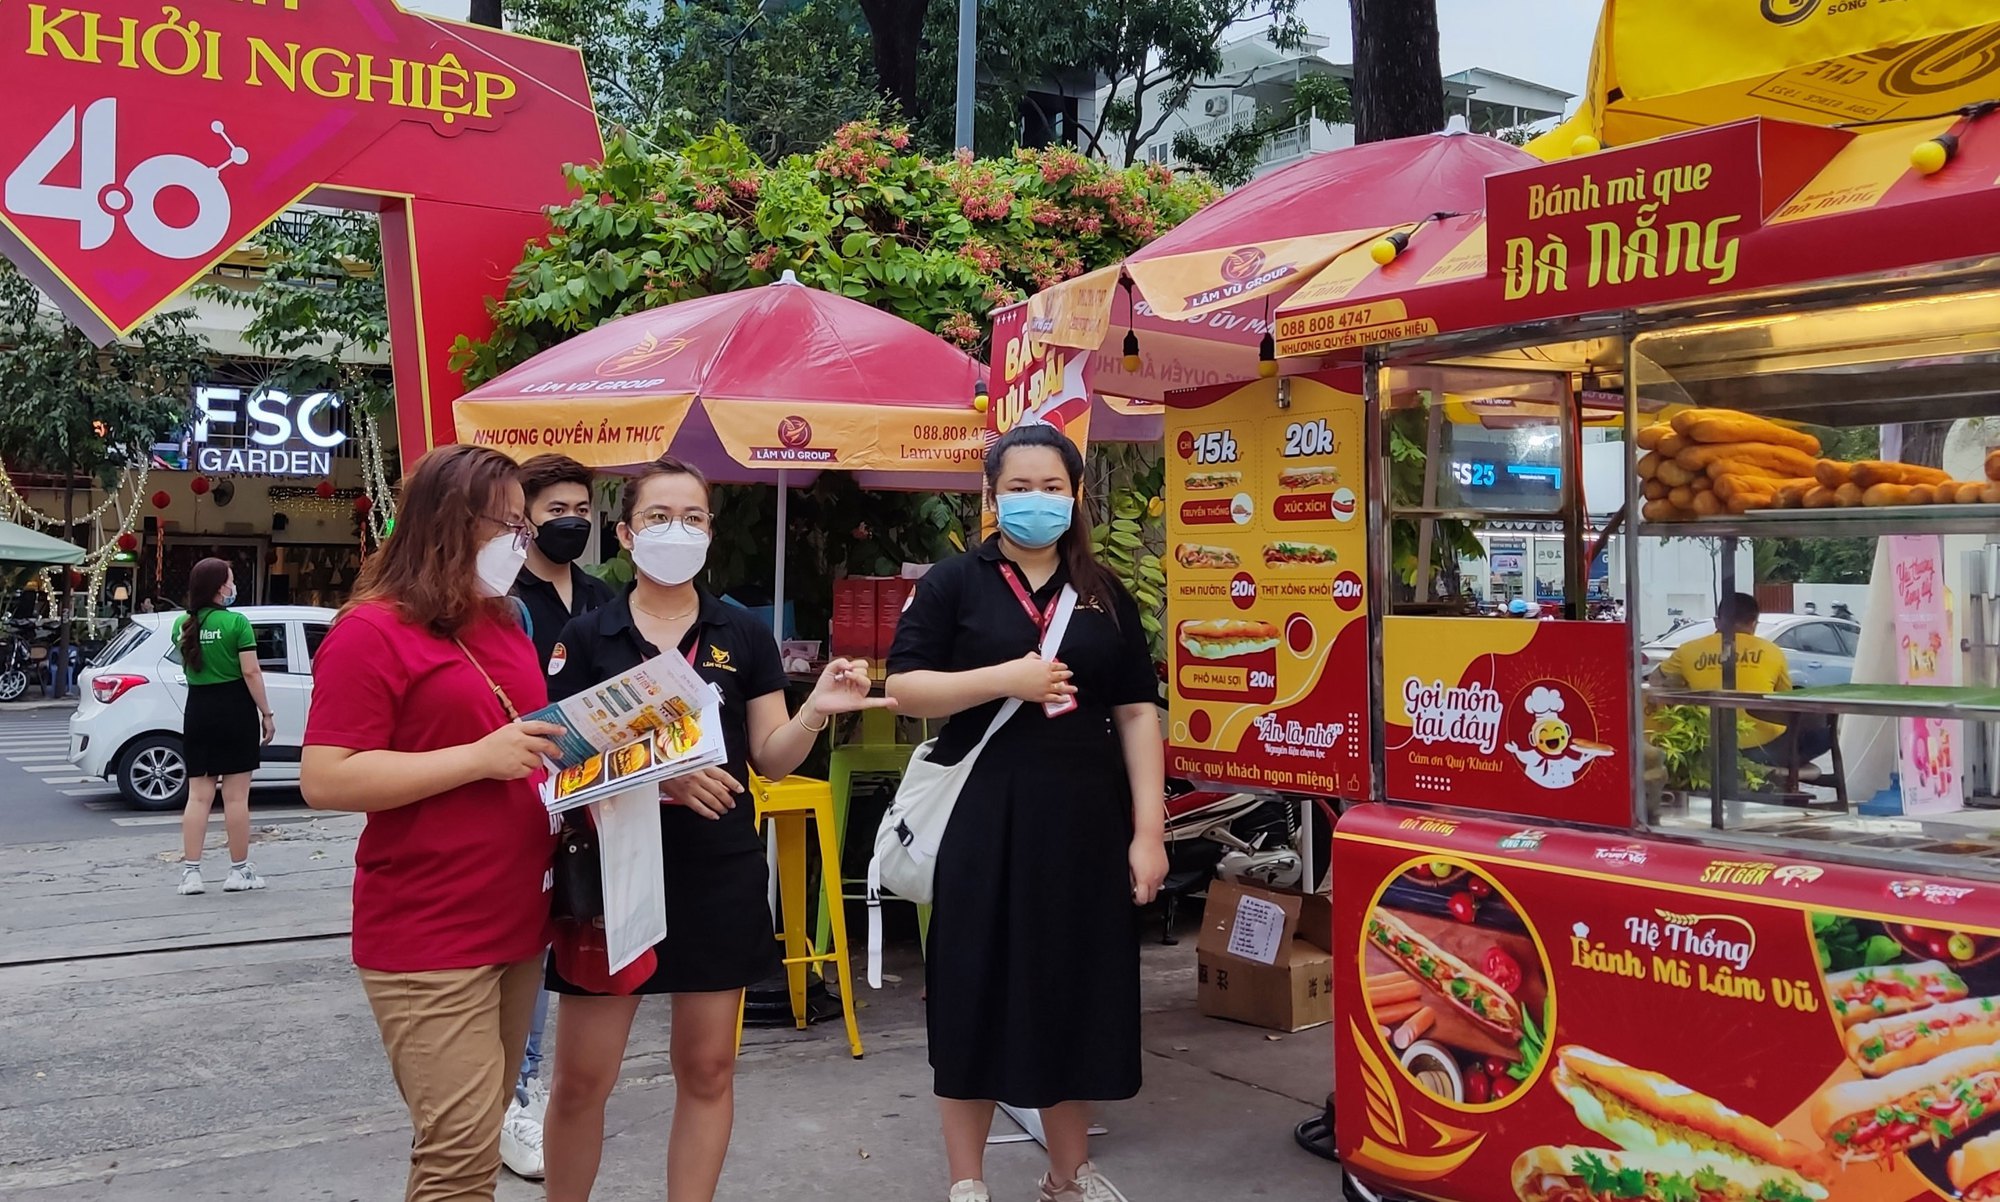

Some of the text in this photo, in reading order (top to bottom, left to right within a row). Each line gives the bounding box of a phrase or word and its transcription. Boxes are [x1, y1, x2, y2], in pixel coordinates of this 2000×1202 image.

[25, 3, 516, 124] KHỞI NGHIỆP
[1528, 162, 1713, 221] Bánh mì que
[1501, 201, 1742, 301] ĐÀ NẴNG
[1192, 292, 1220, 308] LÂM
[1224, 284, 1243, 298] VŨ
[1245, 266, 1288, 291] GROUP
[1281, 309, 1371, 337] 088 808 4747
[1323, 330, 1357, 350] QUYỀN
[1359, 326, 1402, 345] THƯƠNG
[1404, 322, 1429, 339] HIỆU
[519, 381, 561, 394] LÂM
[599, 378, 666, 391] GROUP
[194, 386, 347, 448] FSC
[997, 382, 1025, 433] ƯU
[473, 418, 666, 448] NHƯỢNG QUYỀN ẨM THỰC
[1193, 429, 1237, 465] 15k
[1284, 418, 1333, 457] 20k
[200, 447, 331, 475] GARDEN
[756, 448, 831, 461] LÂM VŨ GROUP
[1206, 504, 1230, 517] THỐNG
[1284, 498, 1327, 514] XÚC XÍCH
[1180, 586, 1196, 596] NEM
[1261, 585, 1279, 598] THỊT
[1281, 582, 1307, 596] XÔNG
[1308, 582, 1331, 596] KHÓI
[1193, 671, 1210, 684] PHÔ
[1211, 674, 1226, 684] MAI
[1228, 675, 1242, 687] SỢI
[1404, 679, 1500, 714] Gọi món
[1286, 720, 1305, 745] là
[1414, 711, 1498, 751] tại đây
[1175, 755, 1201, 773] Chúc
[1204, 761, 1223, 779] quý
[1226, 761, 1260, 781] khách
[1264, 768, 1293, 786] ngon
[1431, 755, 1443, 766] ơn
[1445, 754, 1466, 772] Quý
[1624, 916, 1750, 972] Hệ Thống
[1569, 934, 1819, 1013] Bánh Mì Lâm Vũ
